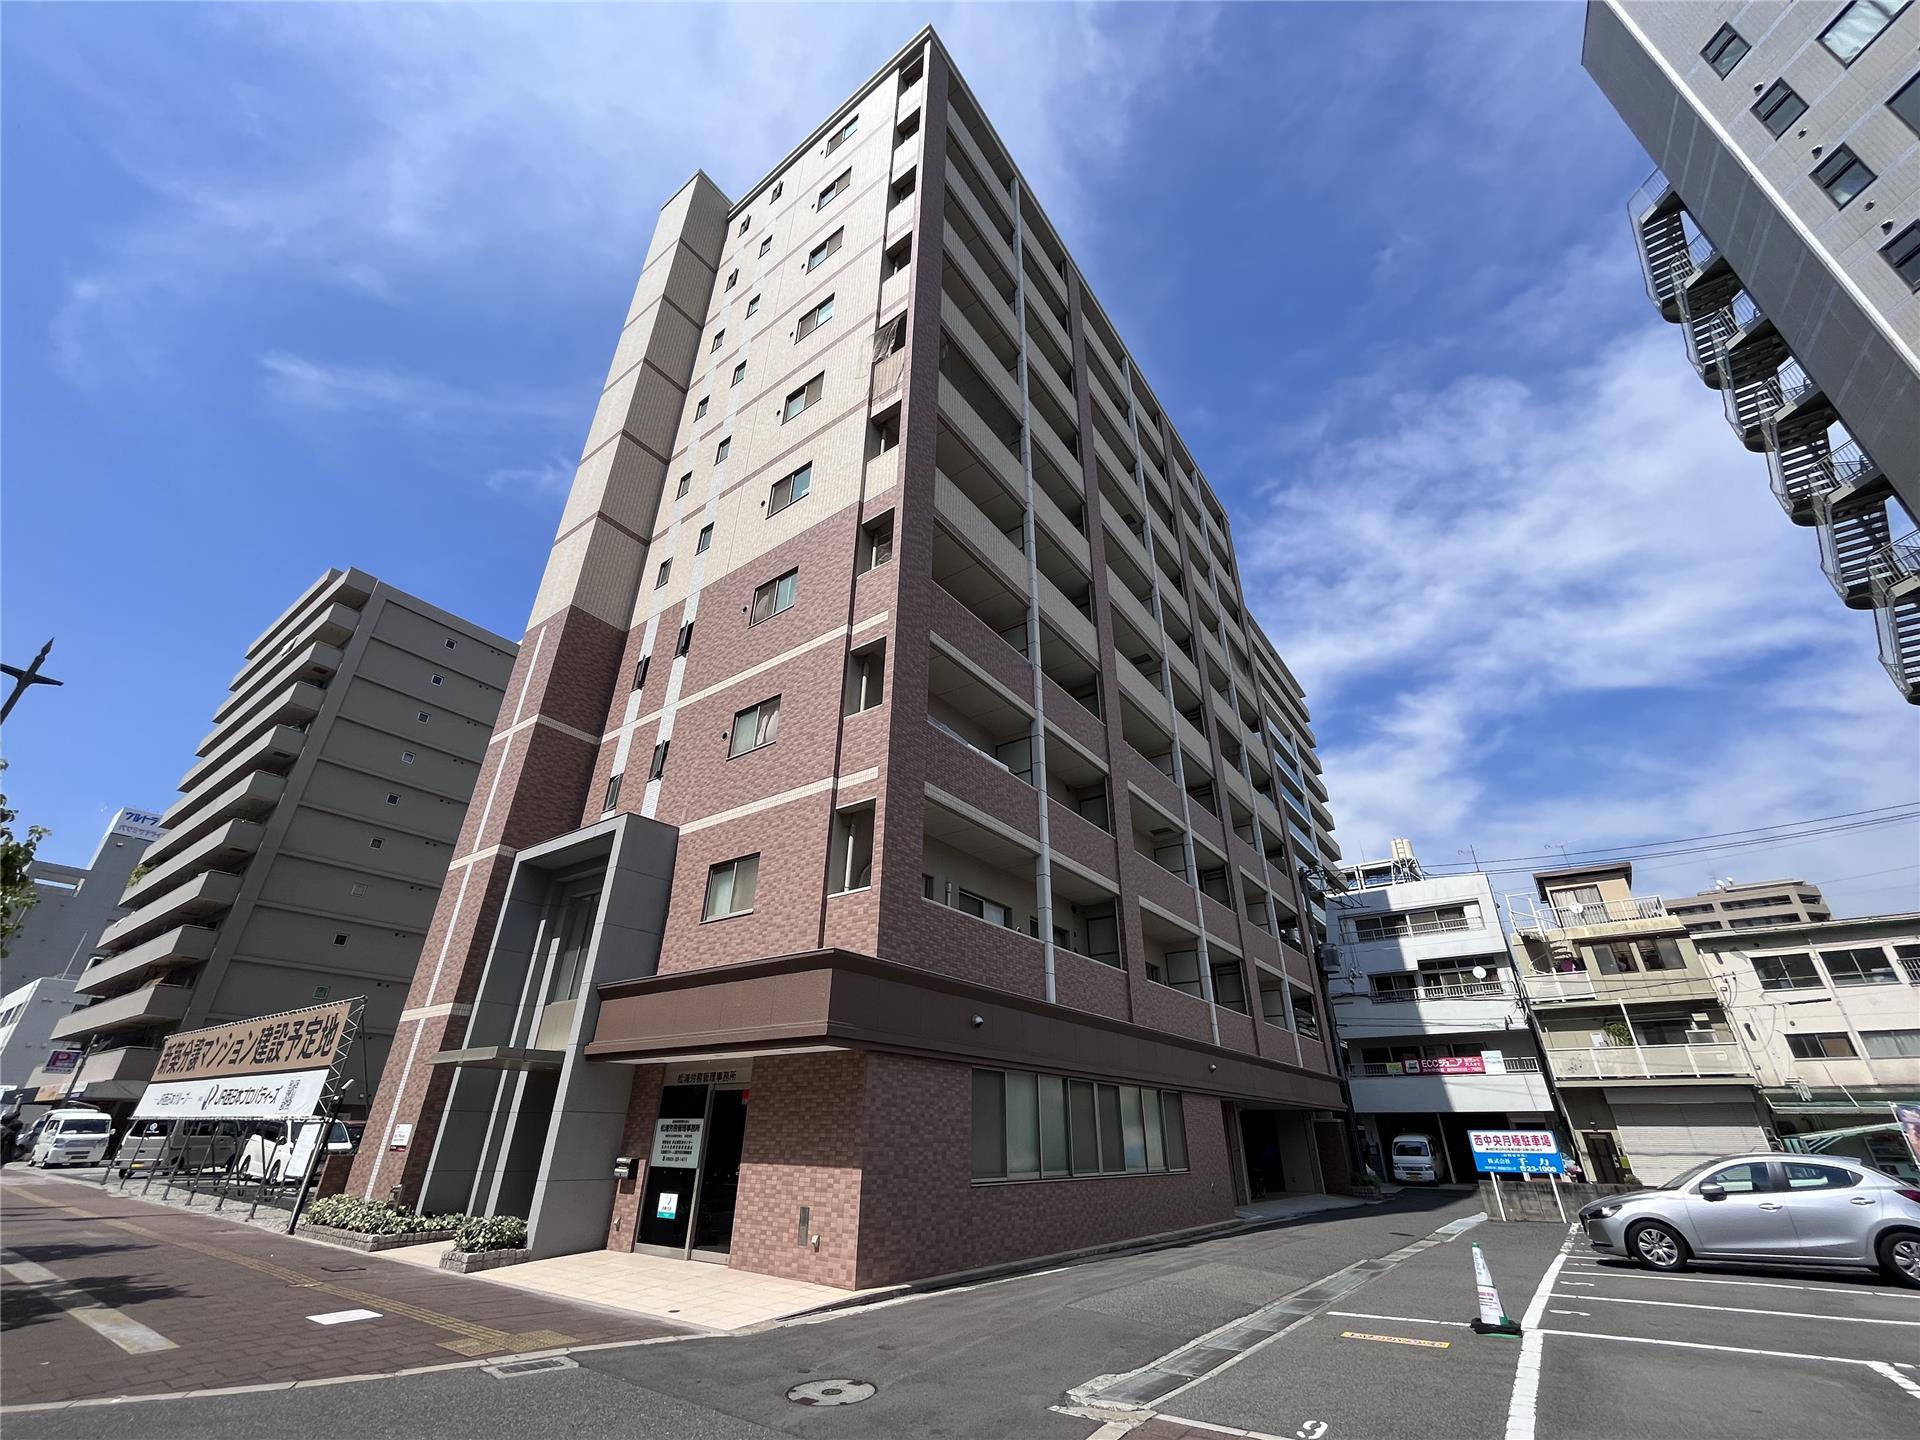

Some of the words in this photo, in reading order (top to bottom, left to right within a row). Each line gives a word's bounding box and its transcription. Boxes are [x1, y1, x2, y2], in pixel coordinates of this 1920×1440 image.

[157, 1012, 340, 1075] 新築分譲マンション建設予定地
[1421, 1058, 1463, 1068] ECCジュニア
[1473, 1134, 1552, 1147] 西中央月極駐車場
